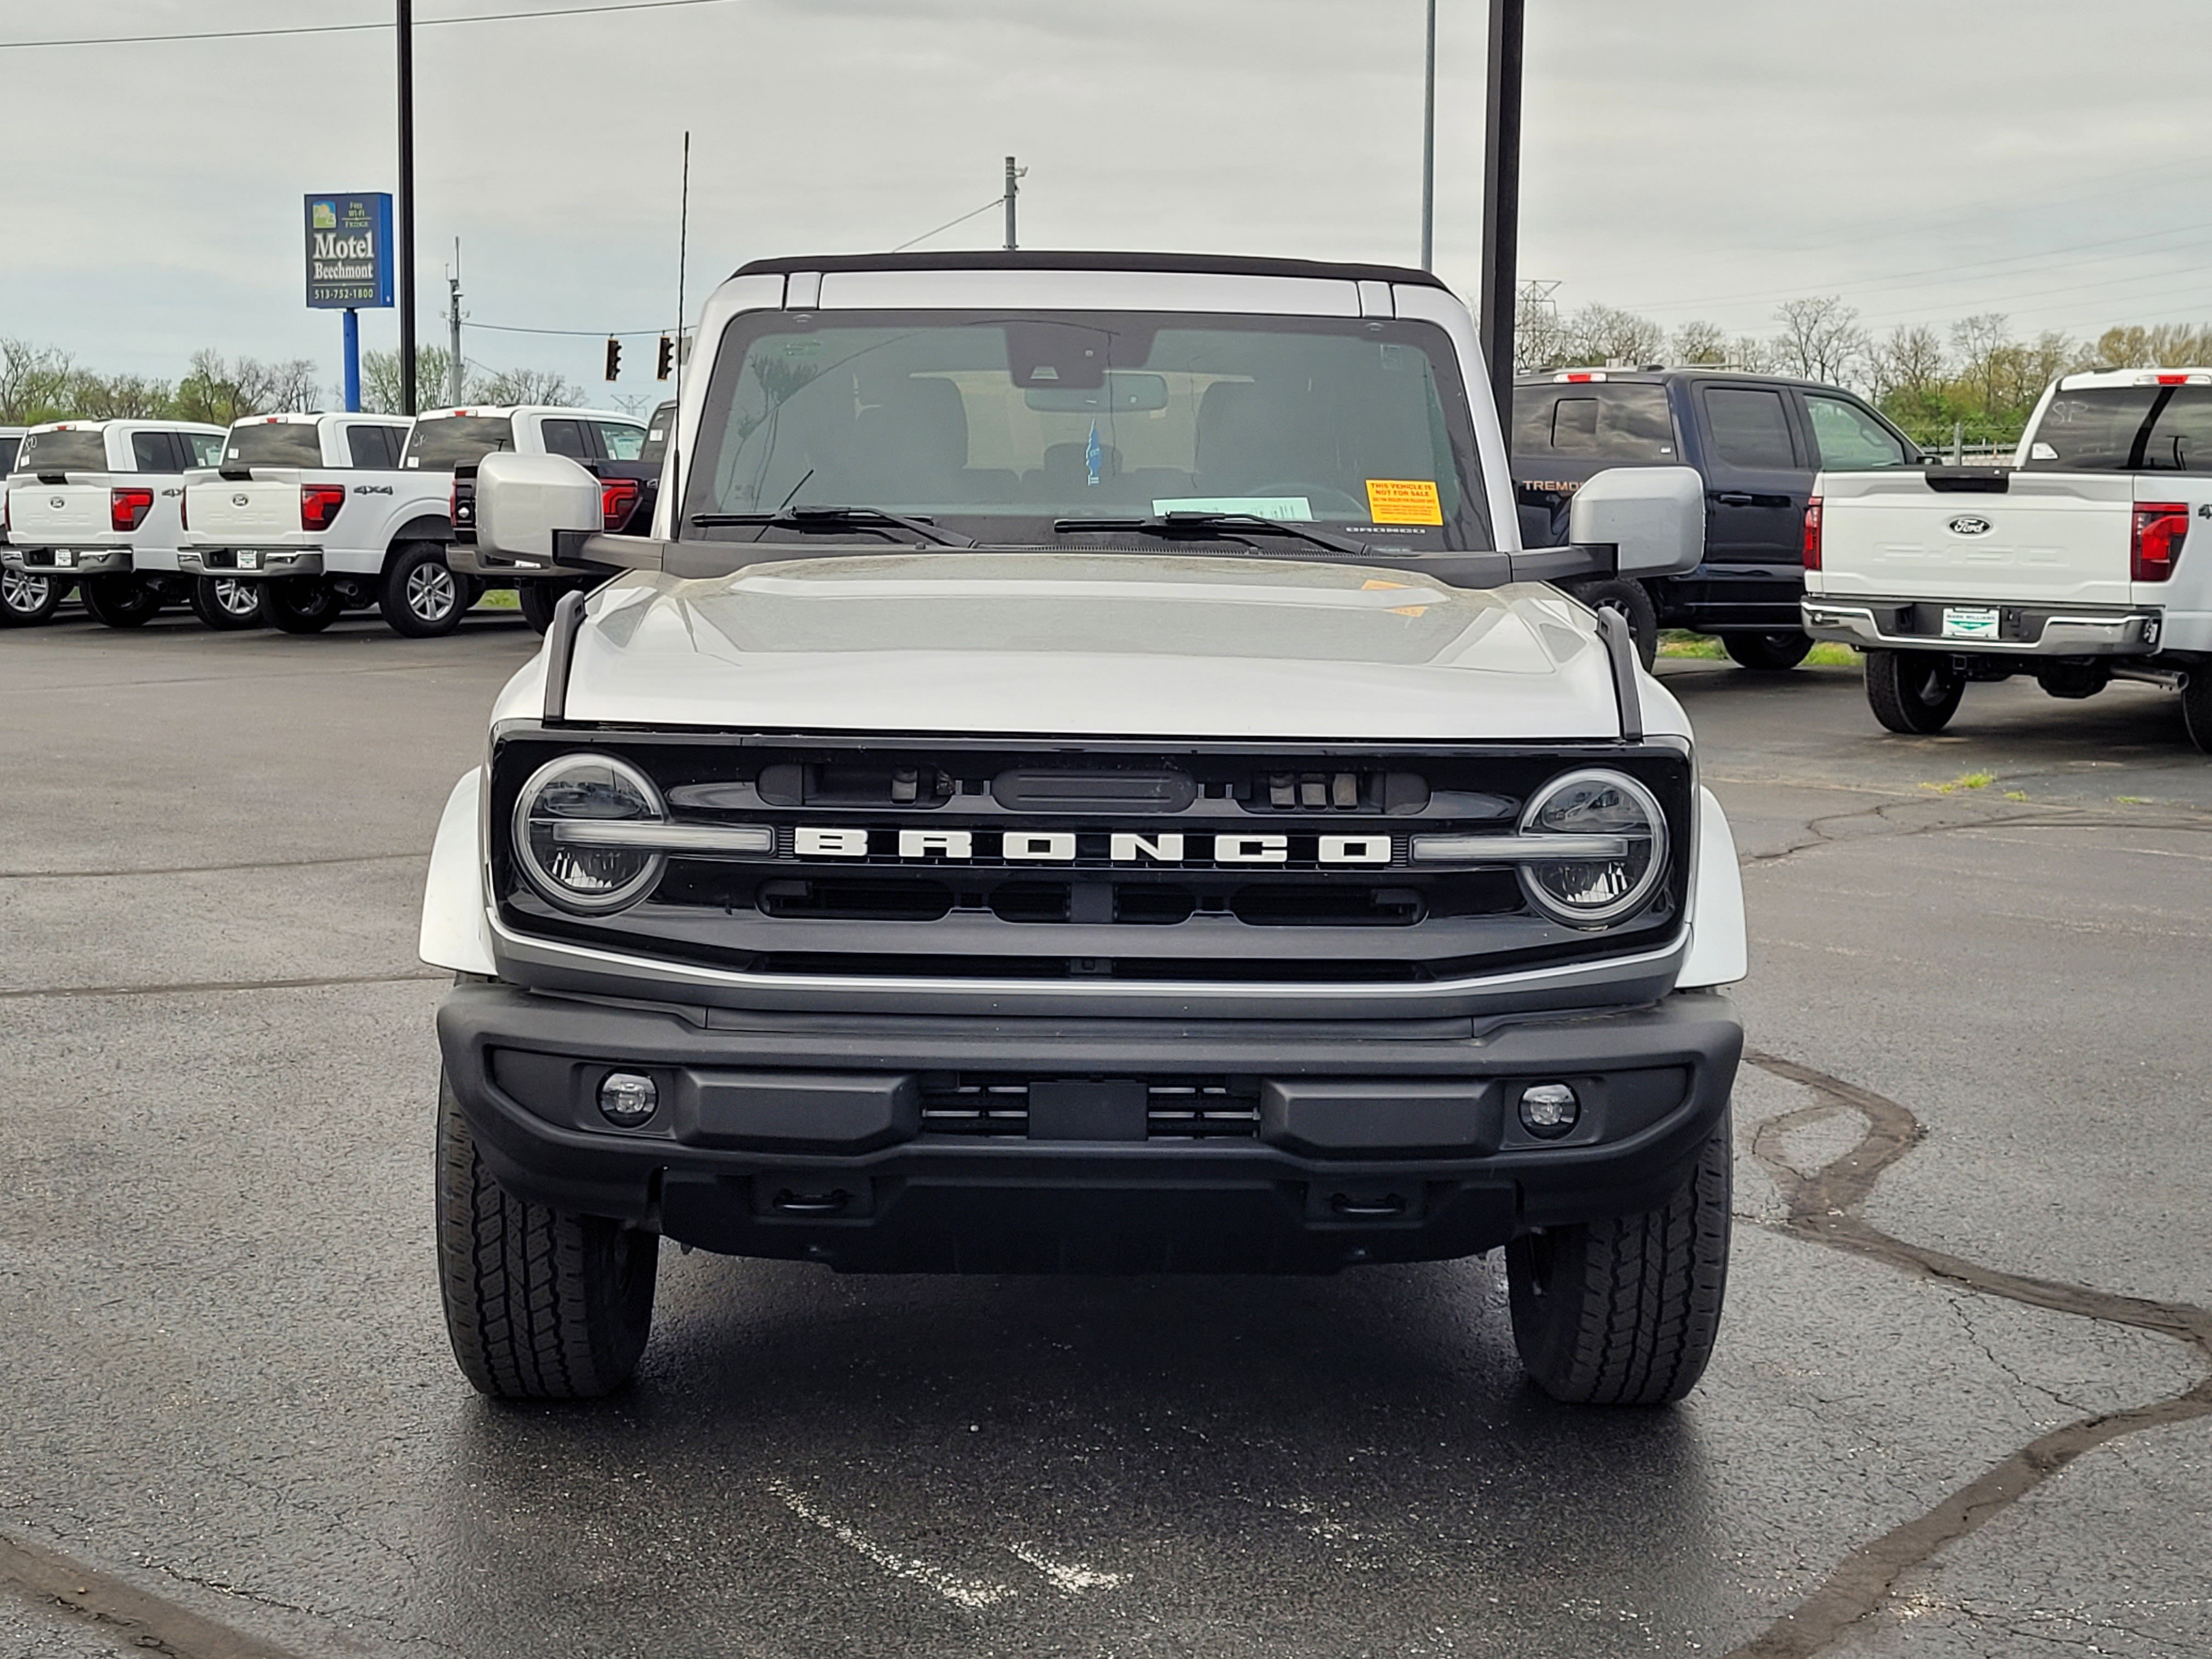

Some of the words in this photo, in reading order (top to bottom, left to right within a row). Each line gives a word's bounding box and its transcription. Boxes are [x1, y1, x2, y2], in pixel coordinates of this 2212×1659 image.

[313, 230, 374, 259] Motel
[313, 260, 374, 280] Beechmont
[1522, 481, 1583, 491] TREMO
[1954, 518, 1985, 533] Ford
[1874, 542, 2070, 566] F-150
[795, 827, 1391, 863] BRONCO
